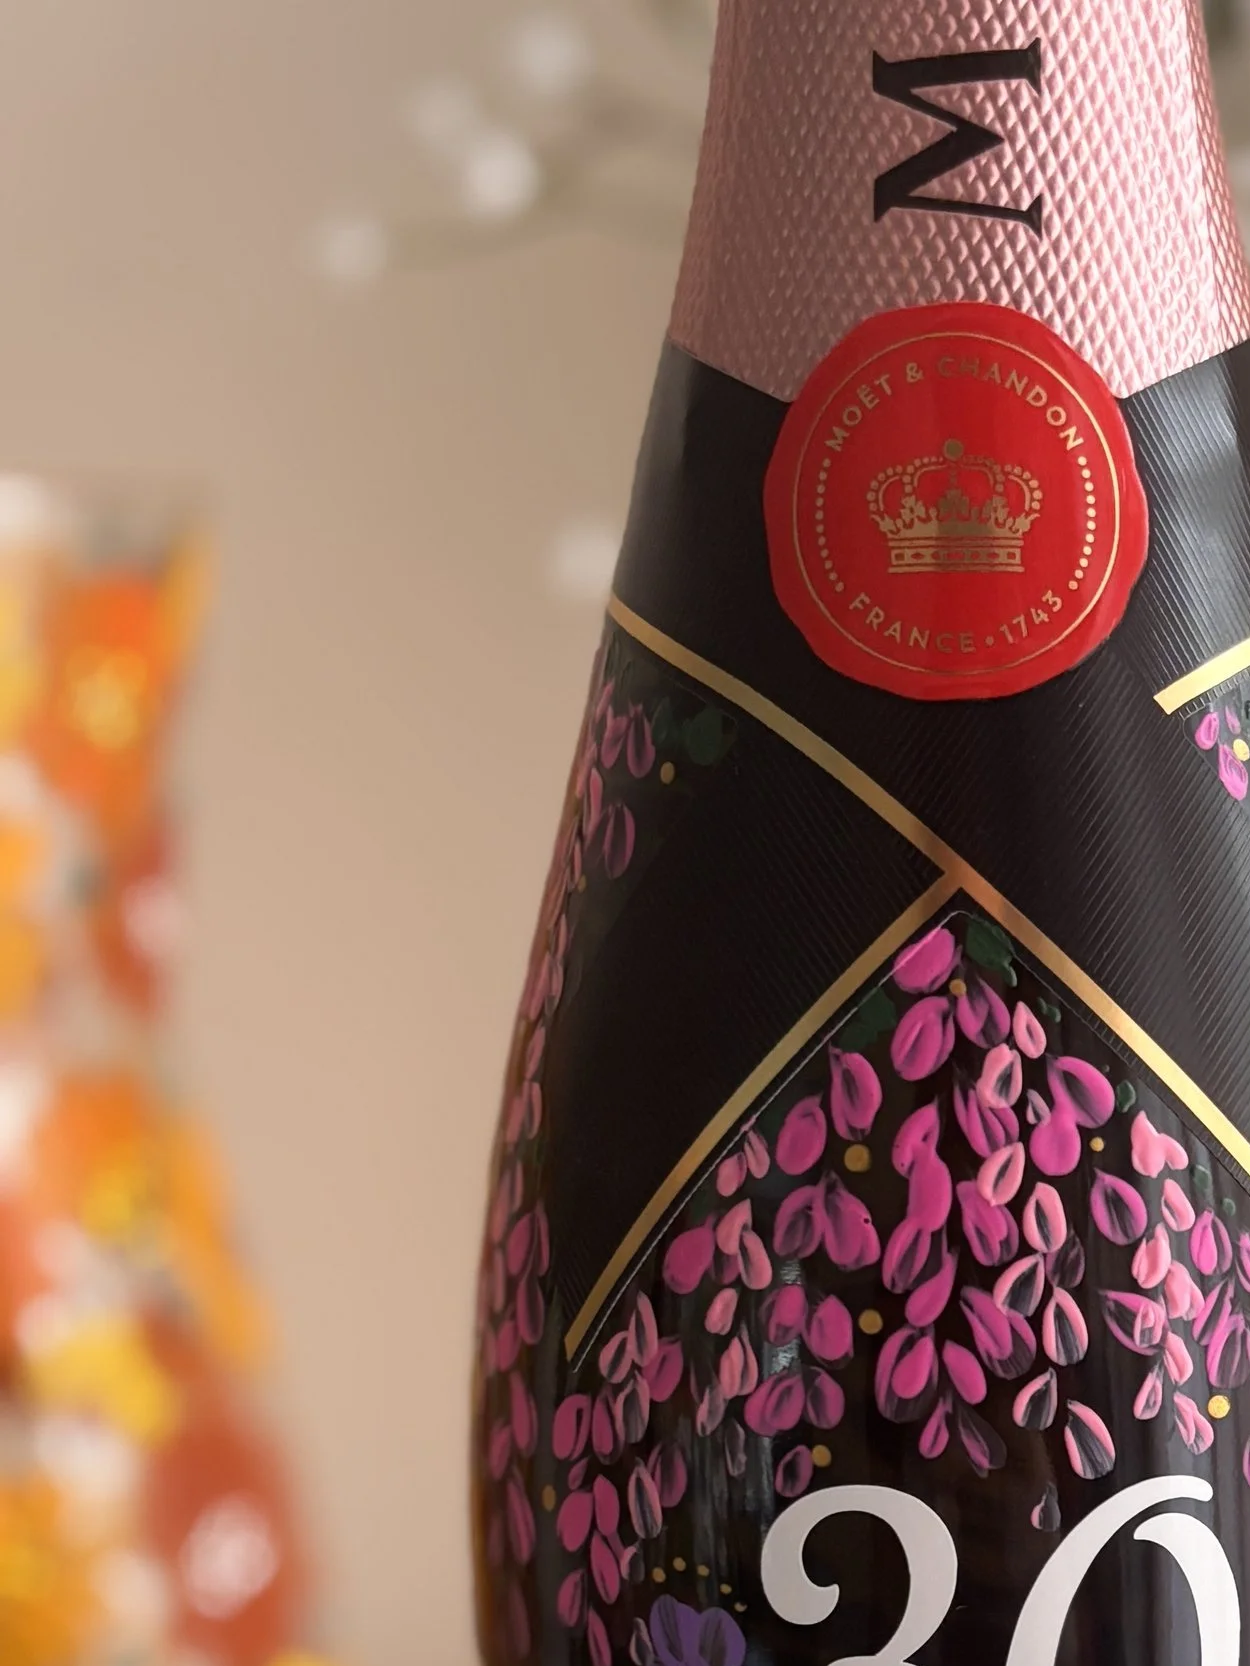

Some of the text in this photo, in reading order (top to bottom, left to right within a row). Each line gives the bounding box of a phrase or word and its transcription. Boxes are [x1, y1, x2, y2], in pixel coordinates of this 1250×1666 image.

[872, 36, 1042, 240] M
[905, 361, 924, 384] &
[937, 356, 1084, 451] CHANDON
[849, 589, 1063, 653] FRANCE 1743
